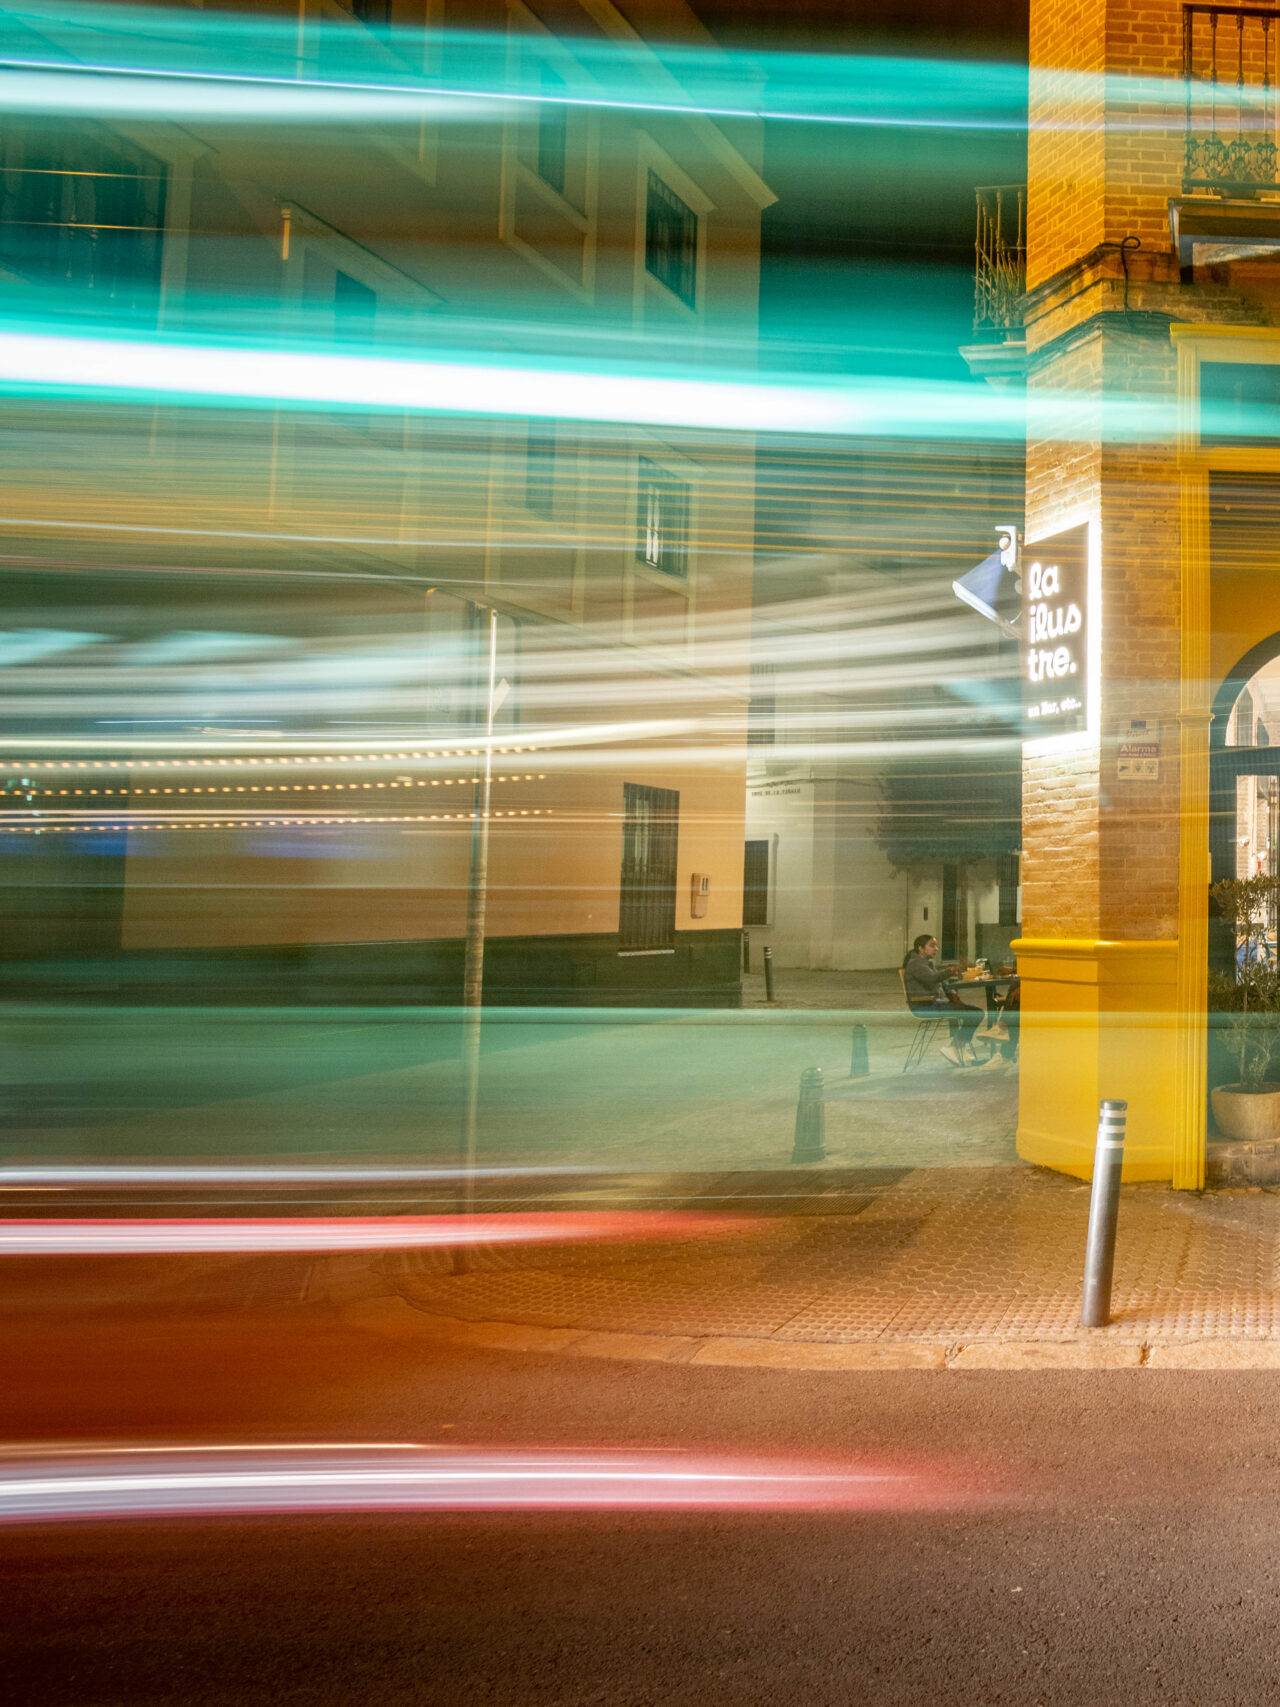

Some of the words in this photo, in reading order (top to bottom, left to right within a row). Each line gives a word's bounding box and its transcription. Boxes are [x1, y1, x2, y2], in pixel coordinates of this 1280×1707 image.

[1029, 561, 1060, 601] la
[1029, 602, 1082, 645] ilus
[1028, 645, 1077, 683] tre.
[1120, 743, 1157, 753] Alarma
